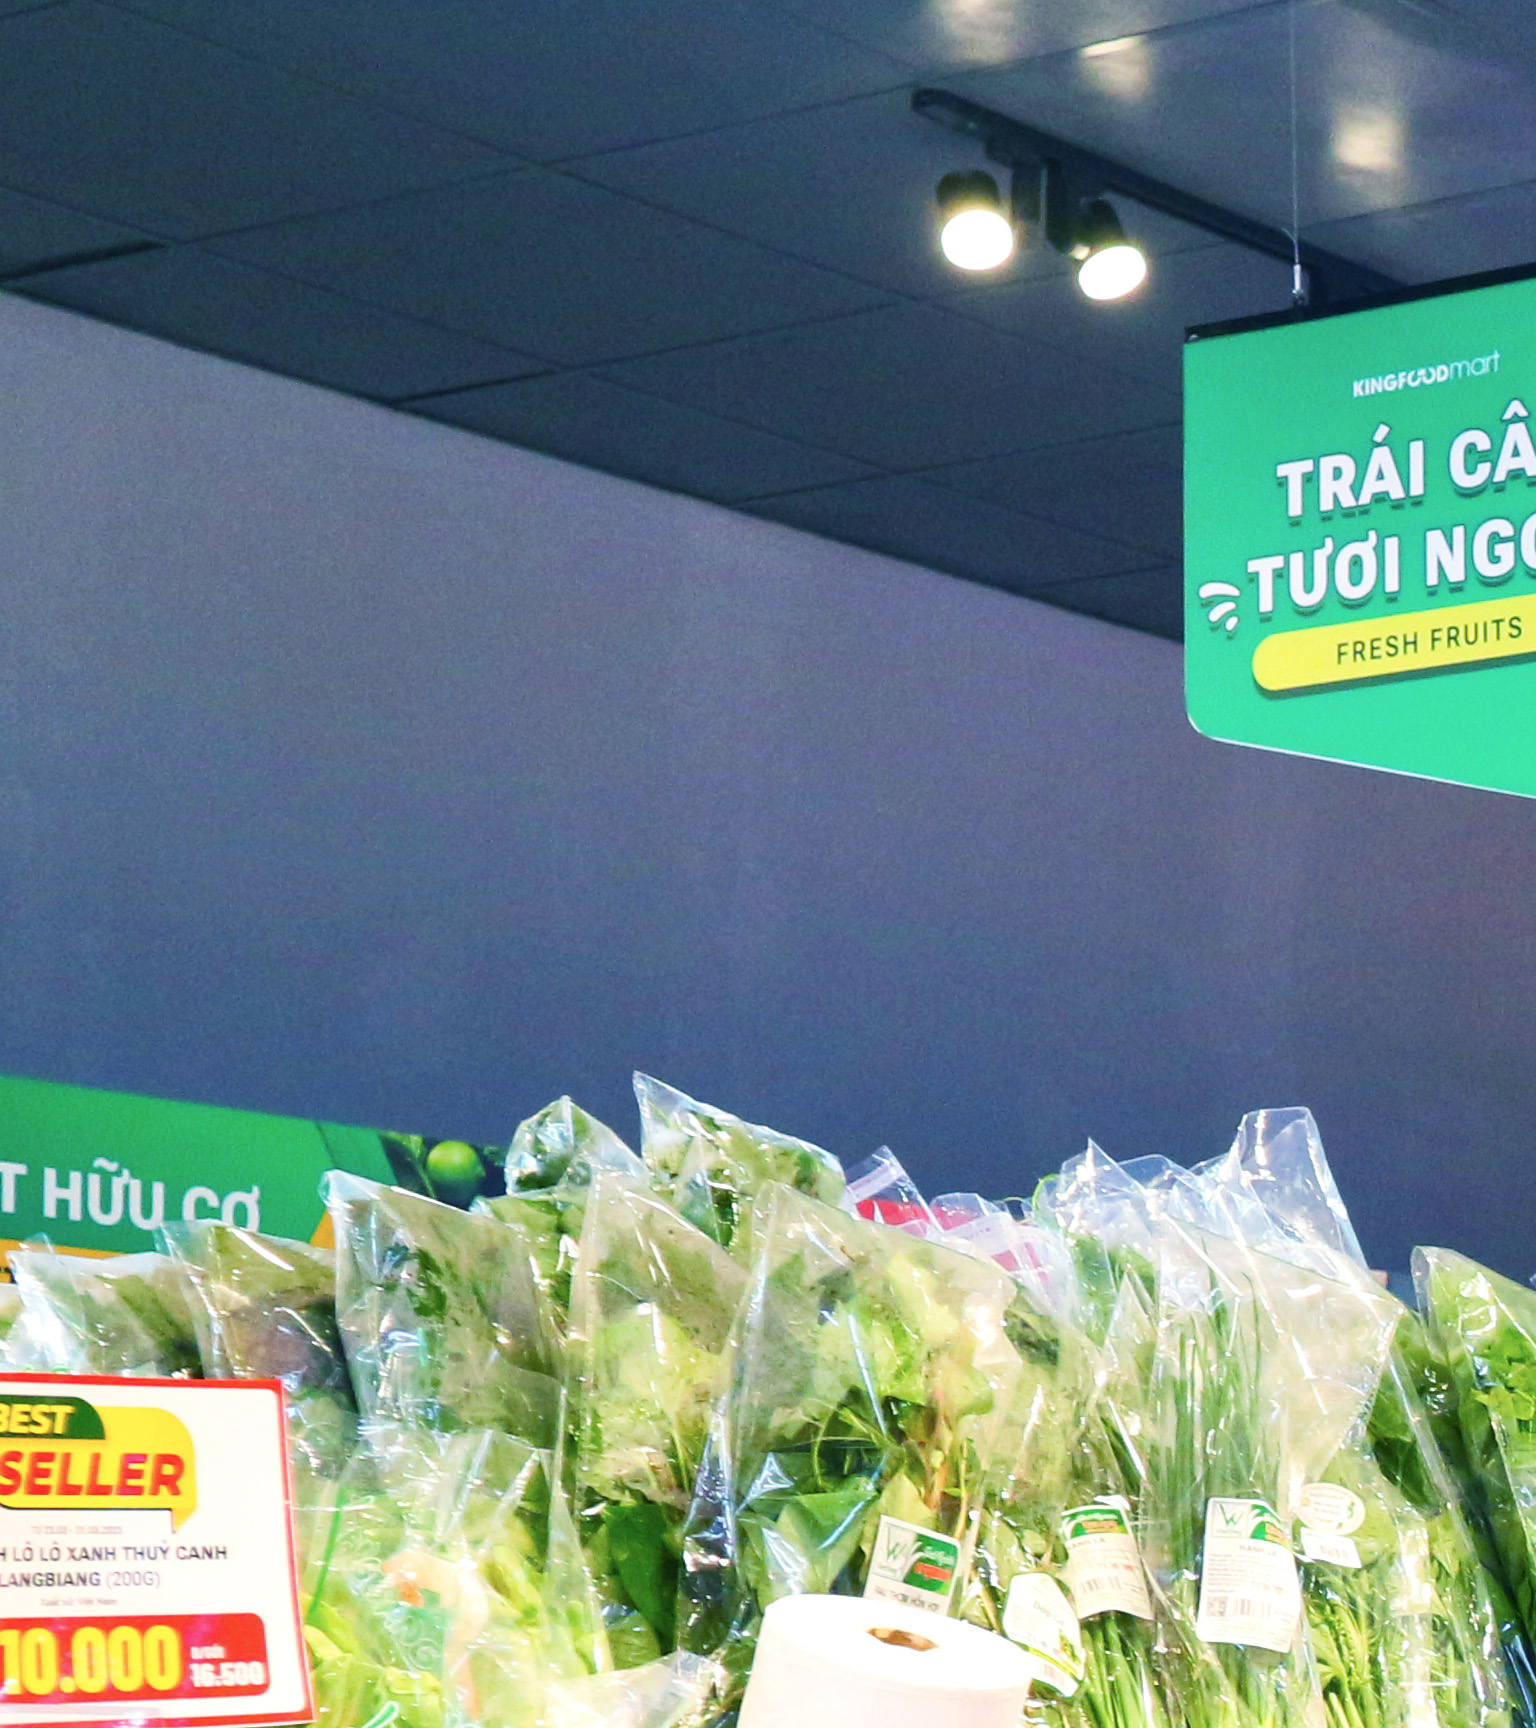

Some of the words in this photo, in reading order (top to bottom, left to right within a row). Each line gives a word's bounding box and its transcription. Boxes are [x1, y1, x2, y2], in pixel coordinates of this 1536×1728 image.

[1277, 422, 1424, 517] TRÁI
[1246, 528, 1399, 614] TƯƠI
[1335, 620, 1420, 667] FRESH
[1430, 615, 1523, 653] FRUITS
[43, 1157, 165, 1230] HỮU
[182, 1184, 261, 1234] CƠ
[0, 1450, 185, 1497] SELLER
[66, 1546, 117, 1562] XANH
[175, 1545, 228, 1561] CANH
[106, 1570, 161, 1590] (200G)
